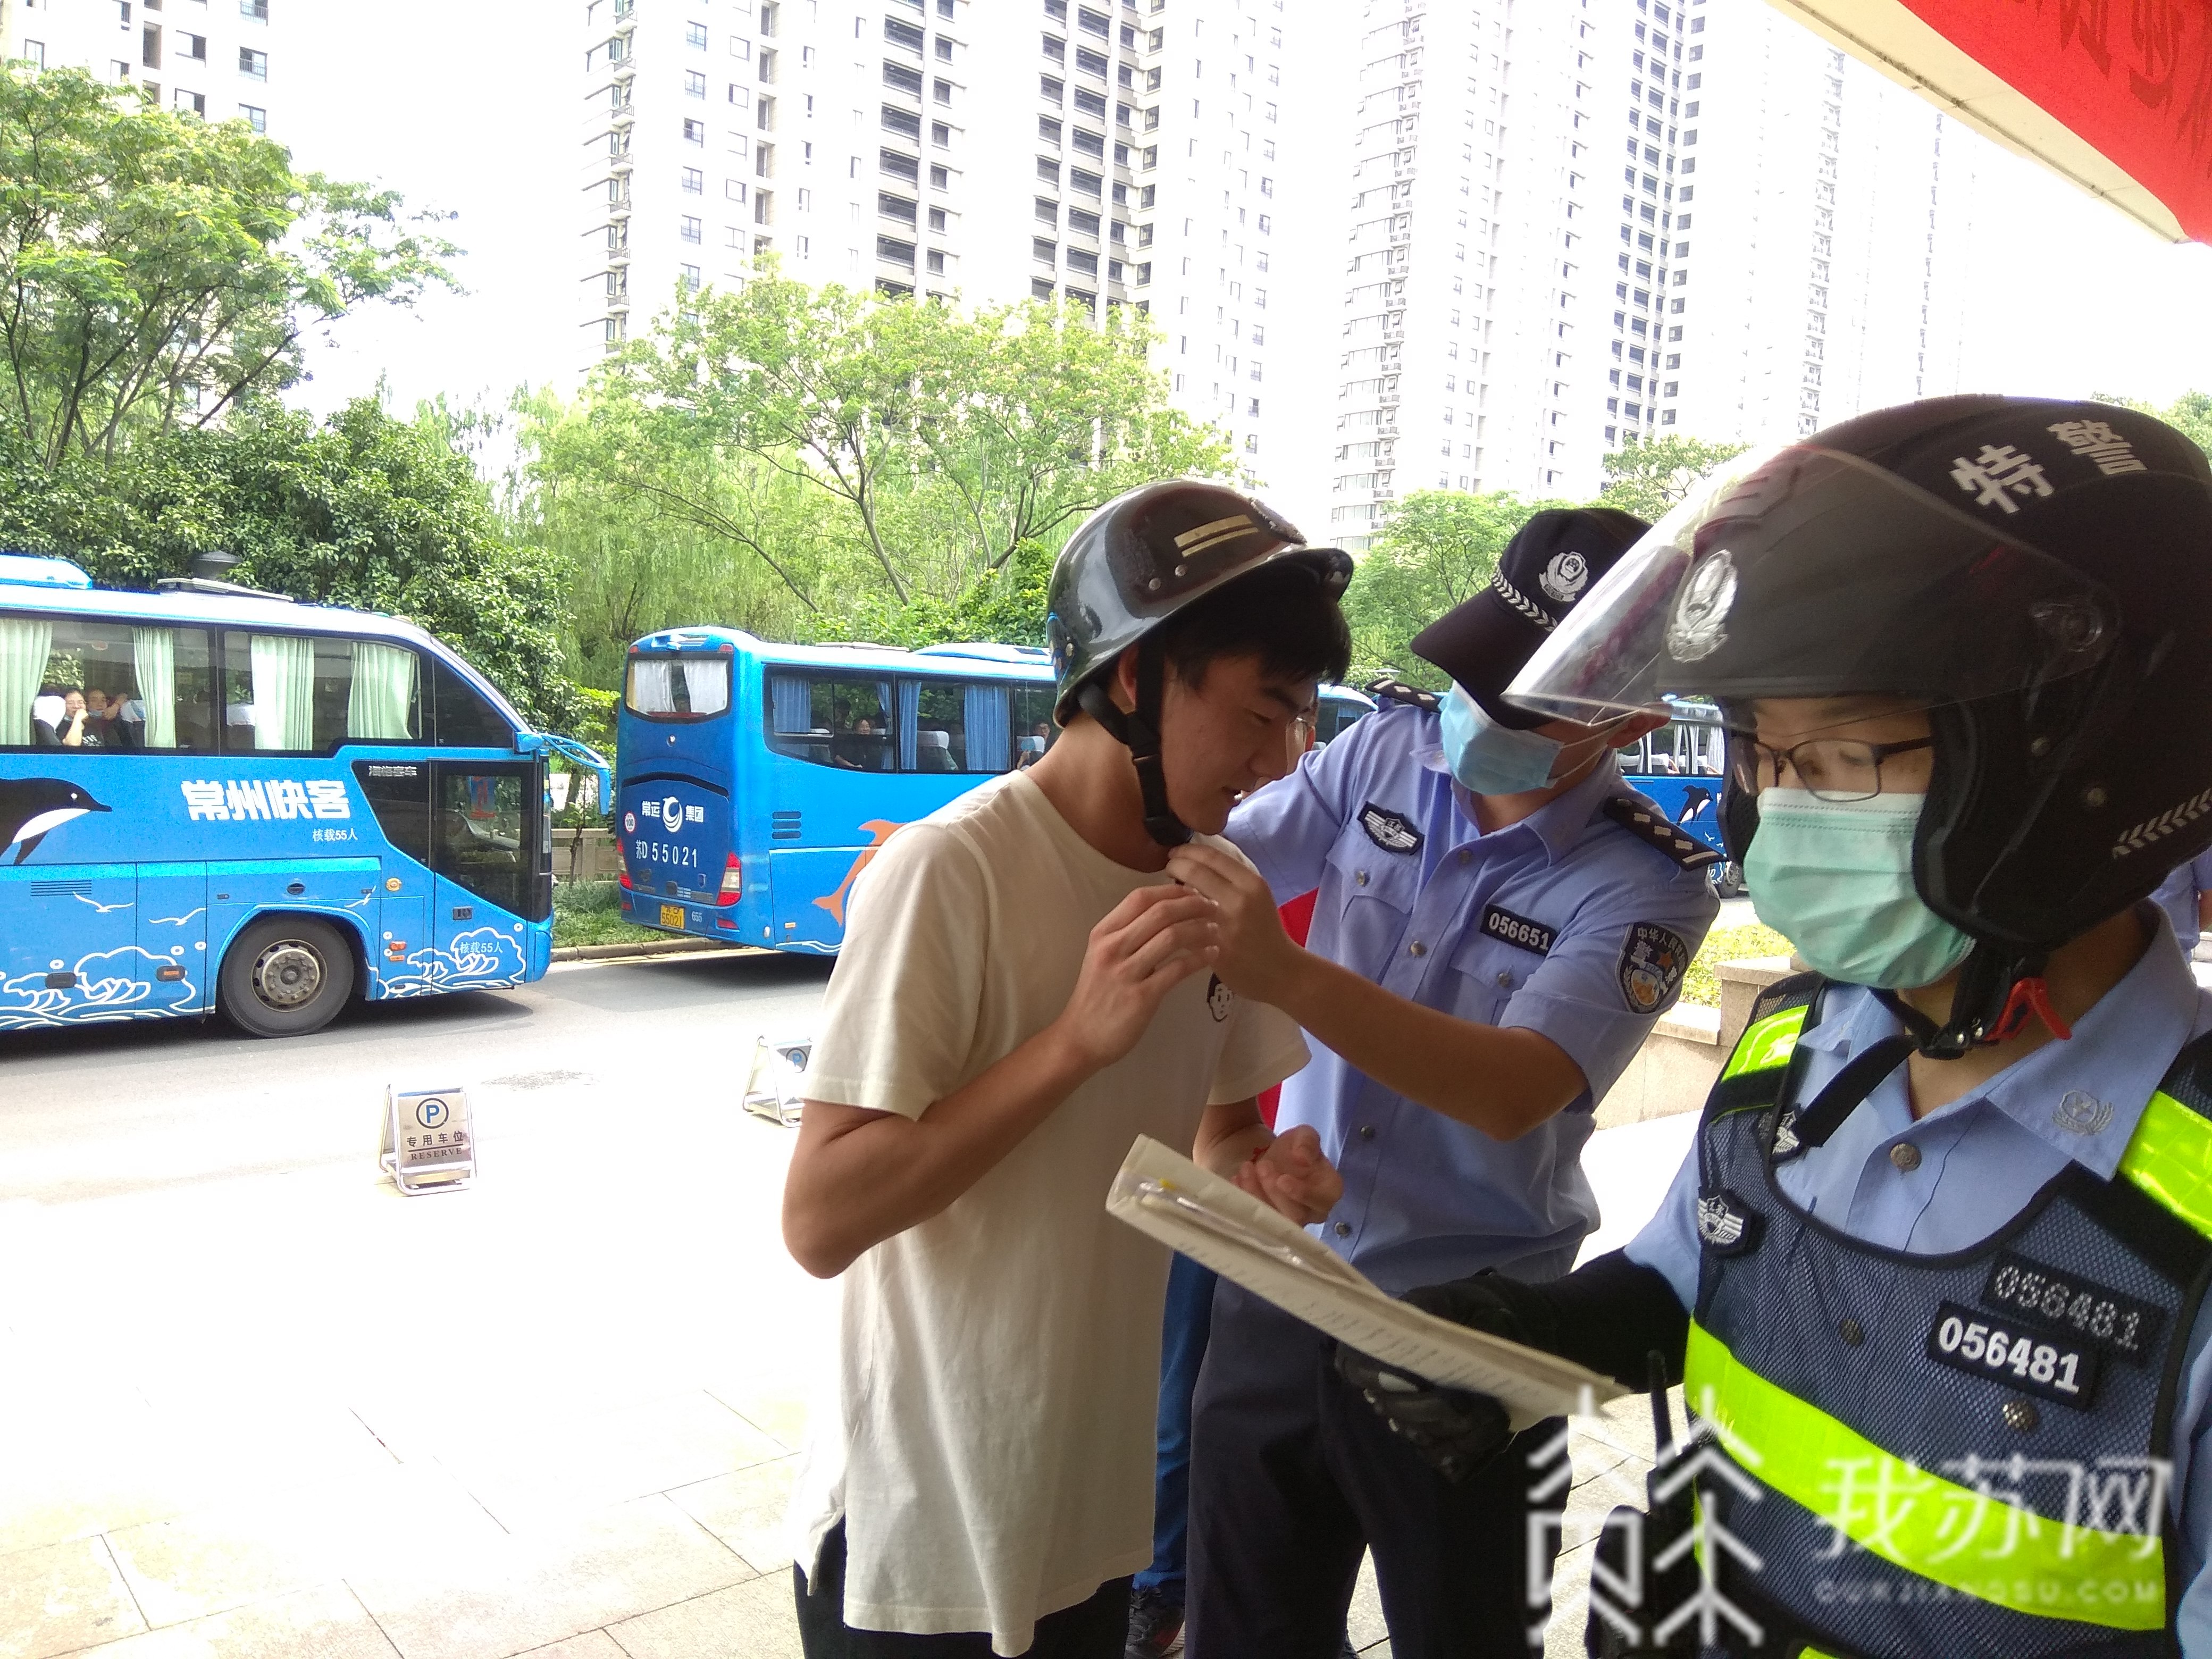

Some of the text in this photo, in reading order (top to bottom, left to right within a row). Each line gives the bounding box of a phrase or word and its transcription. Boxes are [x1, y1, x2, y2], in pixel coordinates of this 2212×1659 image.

[1949, 420, 2148, 514] 特警
[180, 780, 350, 820] 常州快客
[642, 800, 704, 823] 常运 集团
[312, 827, 358, 842] 核载55人
[661, 912, 681, 927] 55021
[1489, 912, 1549, 951] 056651
[459, 942, 503, 954] 核载55人
[426, 1104, 440, 1123] P
[407, 1130, 464, 1147] 专用车位
[411, 1147, 462, 1160] RESERVE
[1995, 1265, 2140, 1351] 056481
[1938, 1317, 2080, 1394] 056481
